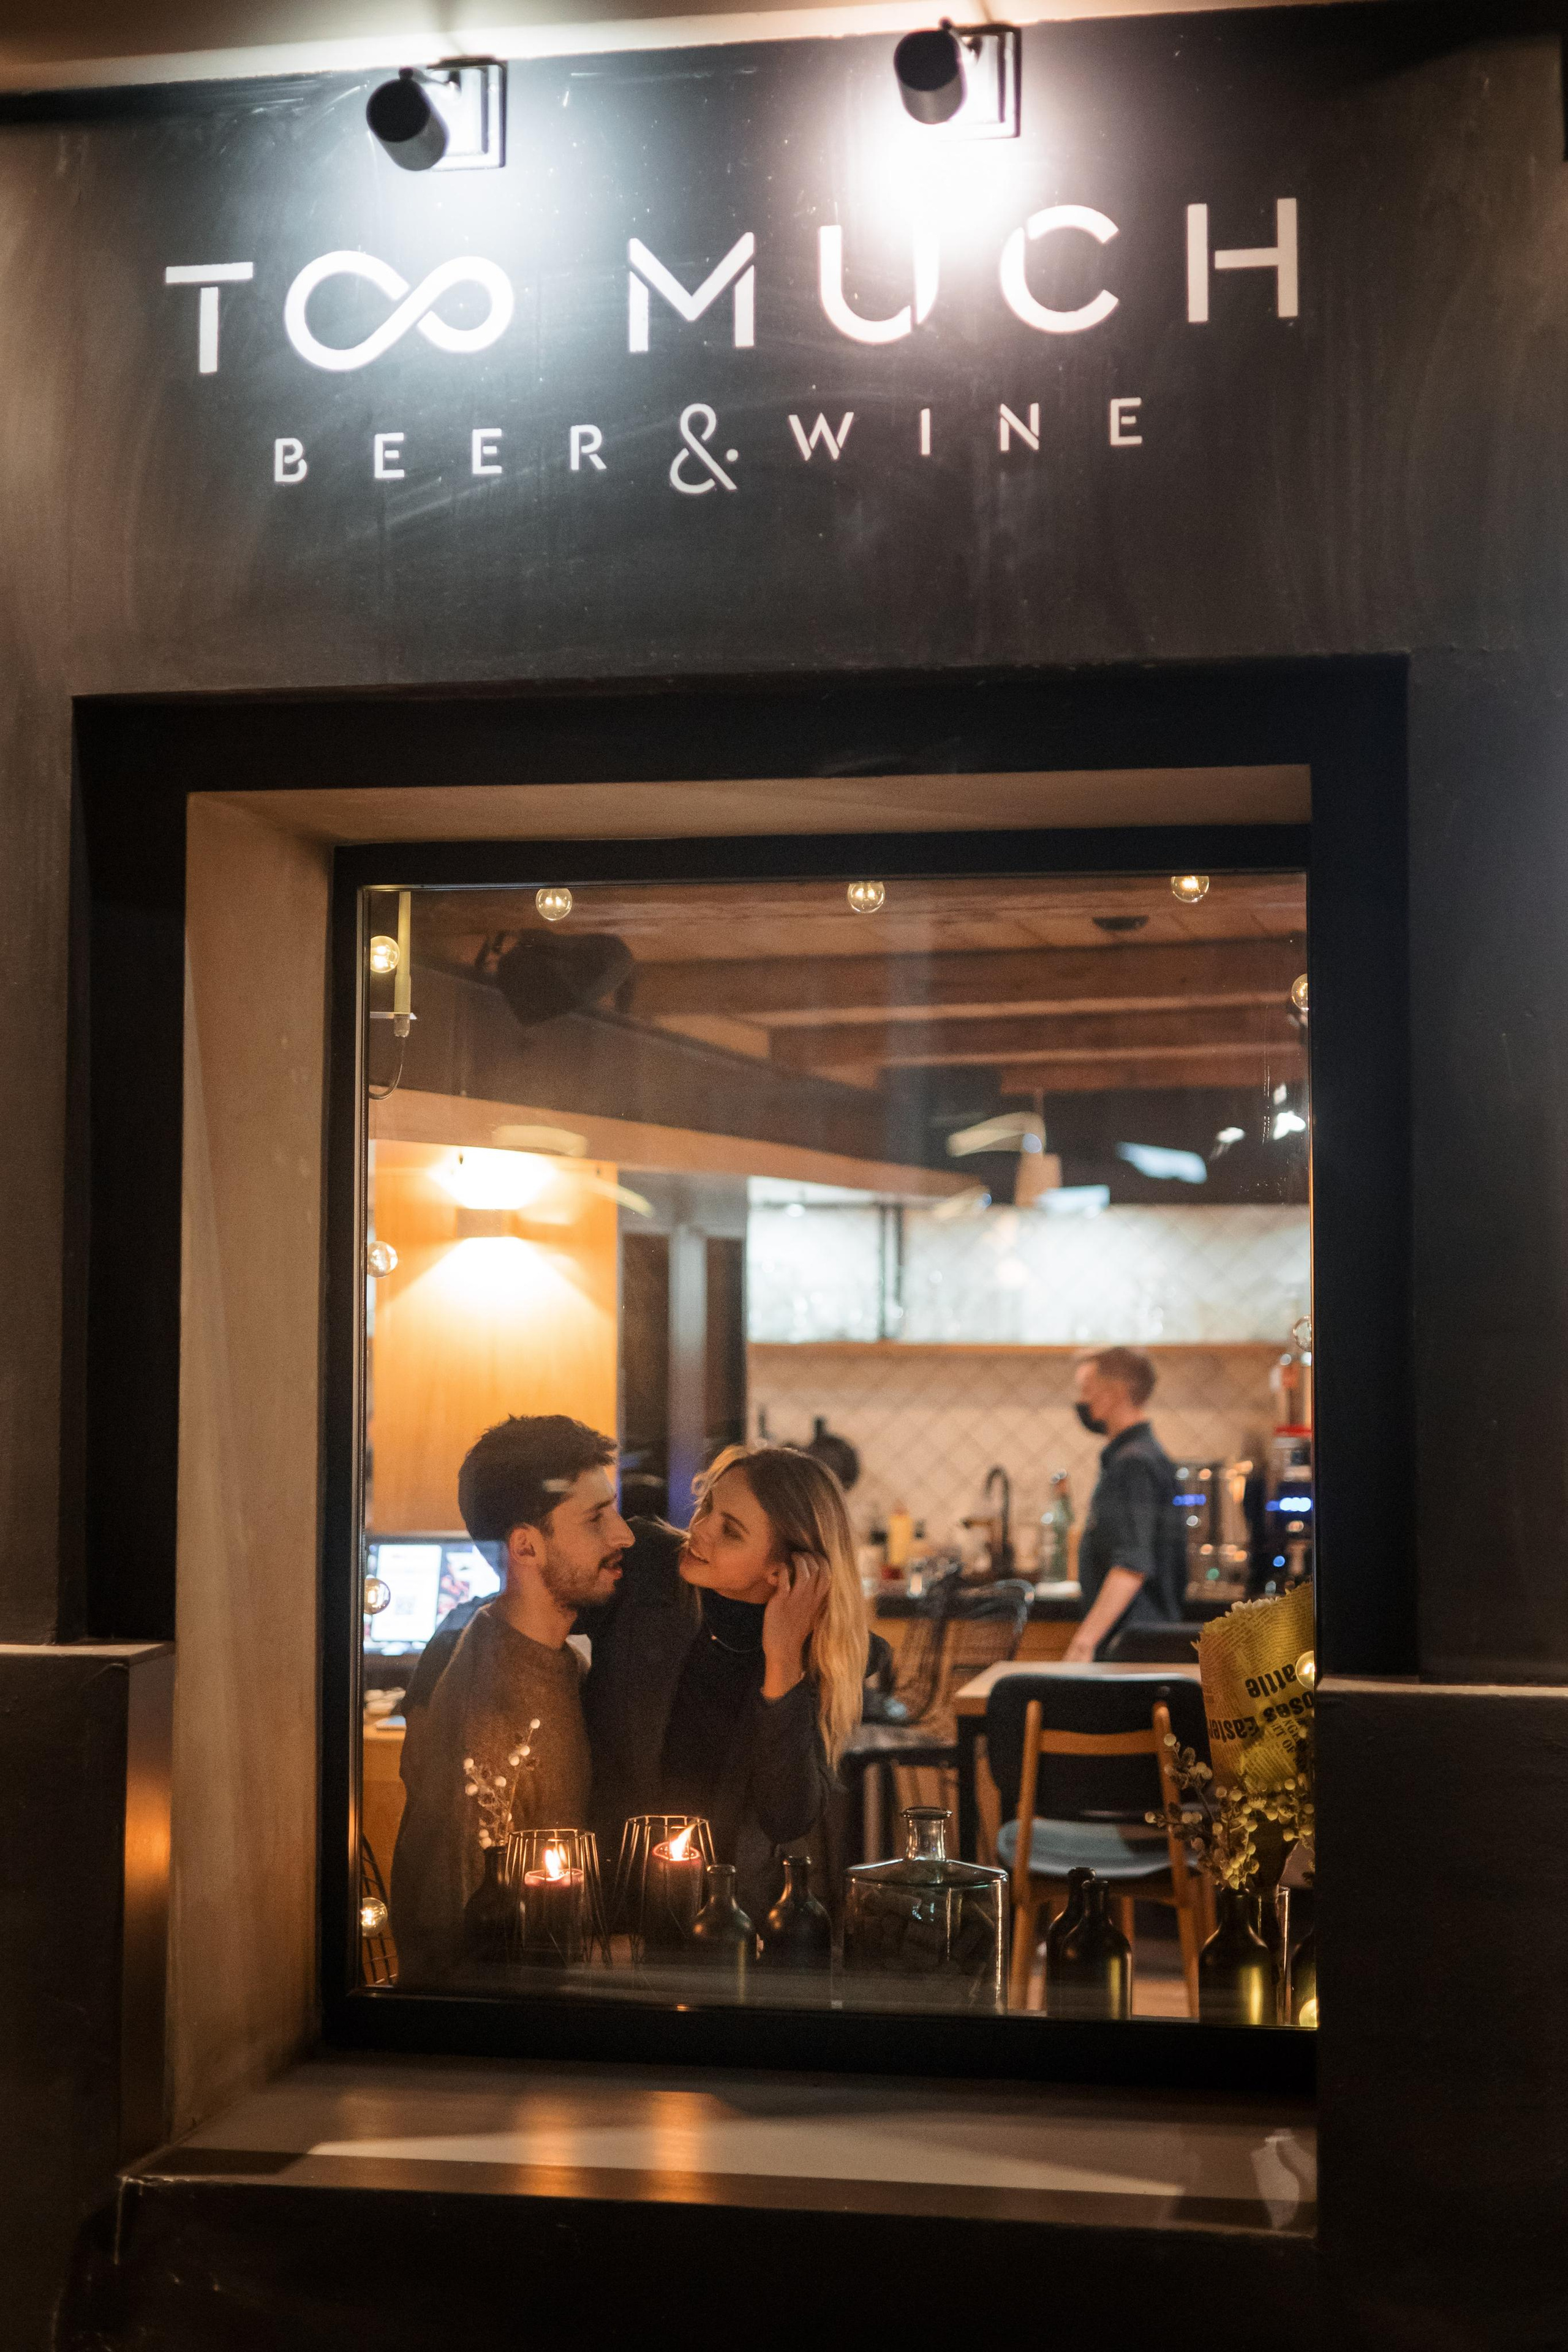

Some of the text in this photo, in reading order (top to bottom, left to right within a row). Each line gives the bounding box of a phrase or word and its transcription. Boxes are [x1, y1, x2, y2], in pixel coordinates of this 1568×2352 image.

[628, 197, 1298, 353] MUCH
[274, 424, 608, 483] BEER
[788, 397, 1143, 461] WINE
[1245, 1660, 1298, 1698] attle
